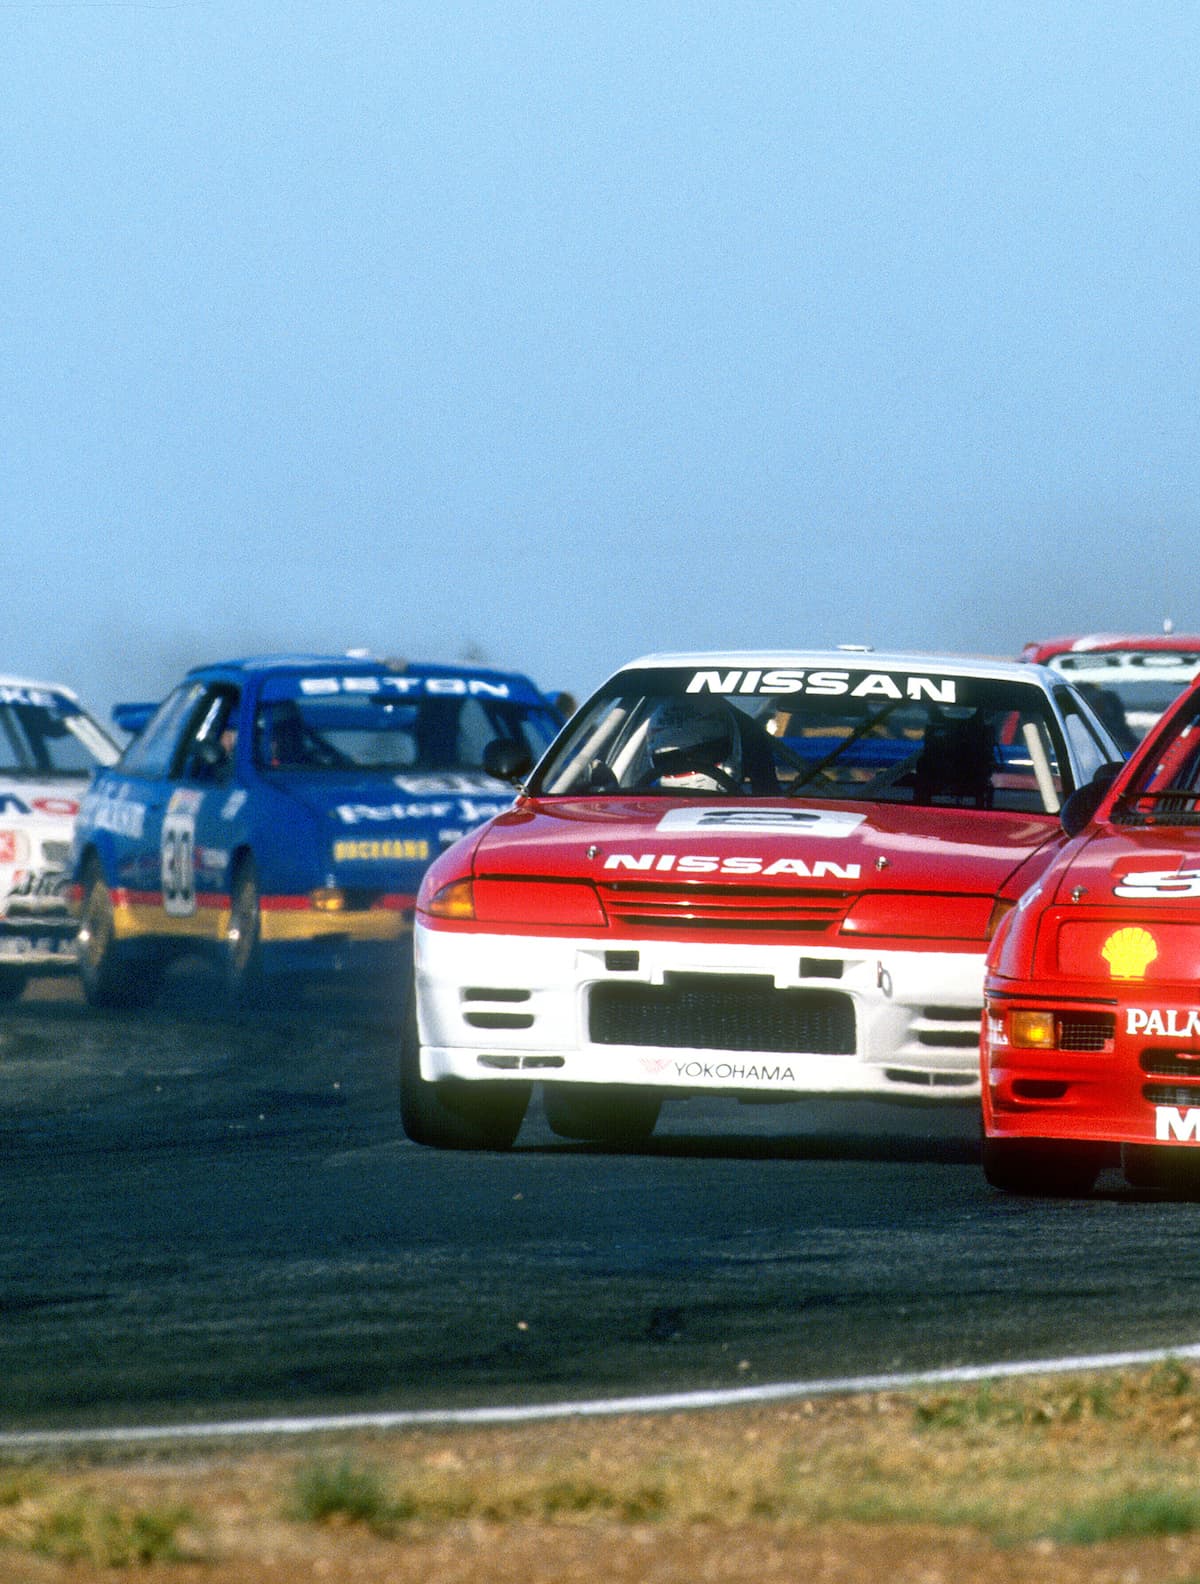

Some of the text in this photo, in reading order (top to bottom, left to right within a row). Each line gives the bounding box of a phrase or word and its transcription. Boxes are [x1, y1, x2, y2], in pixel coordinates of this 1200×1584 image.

[686, 670, 956, 703] NISSAN
[697, 811, 821, 828] 2
[603, 854, 861, 879] NISSAN
[675, 1062, 796, 1081] YOKOHAMA
